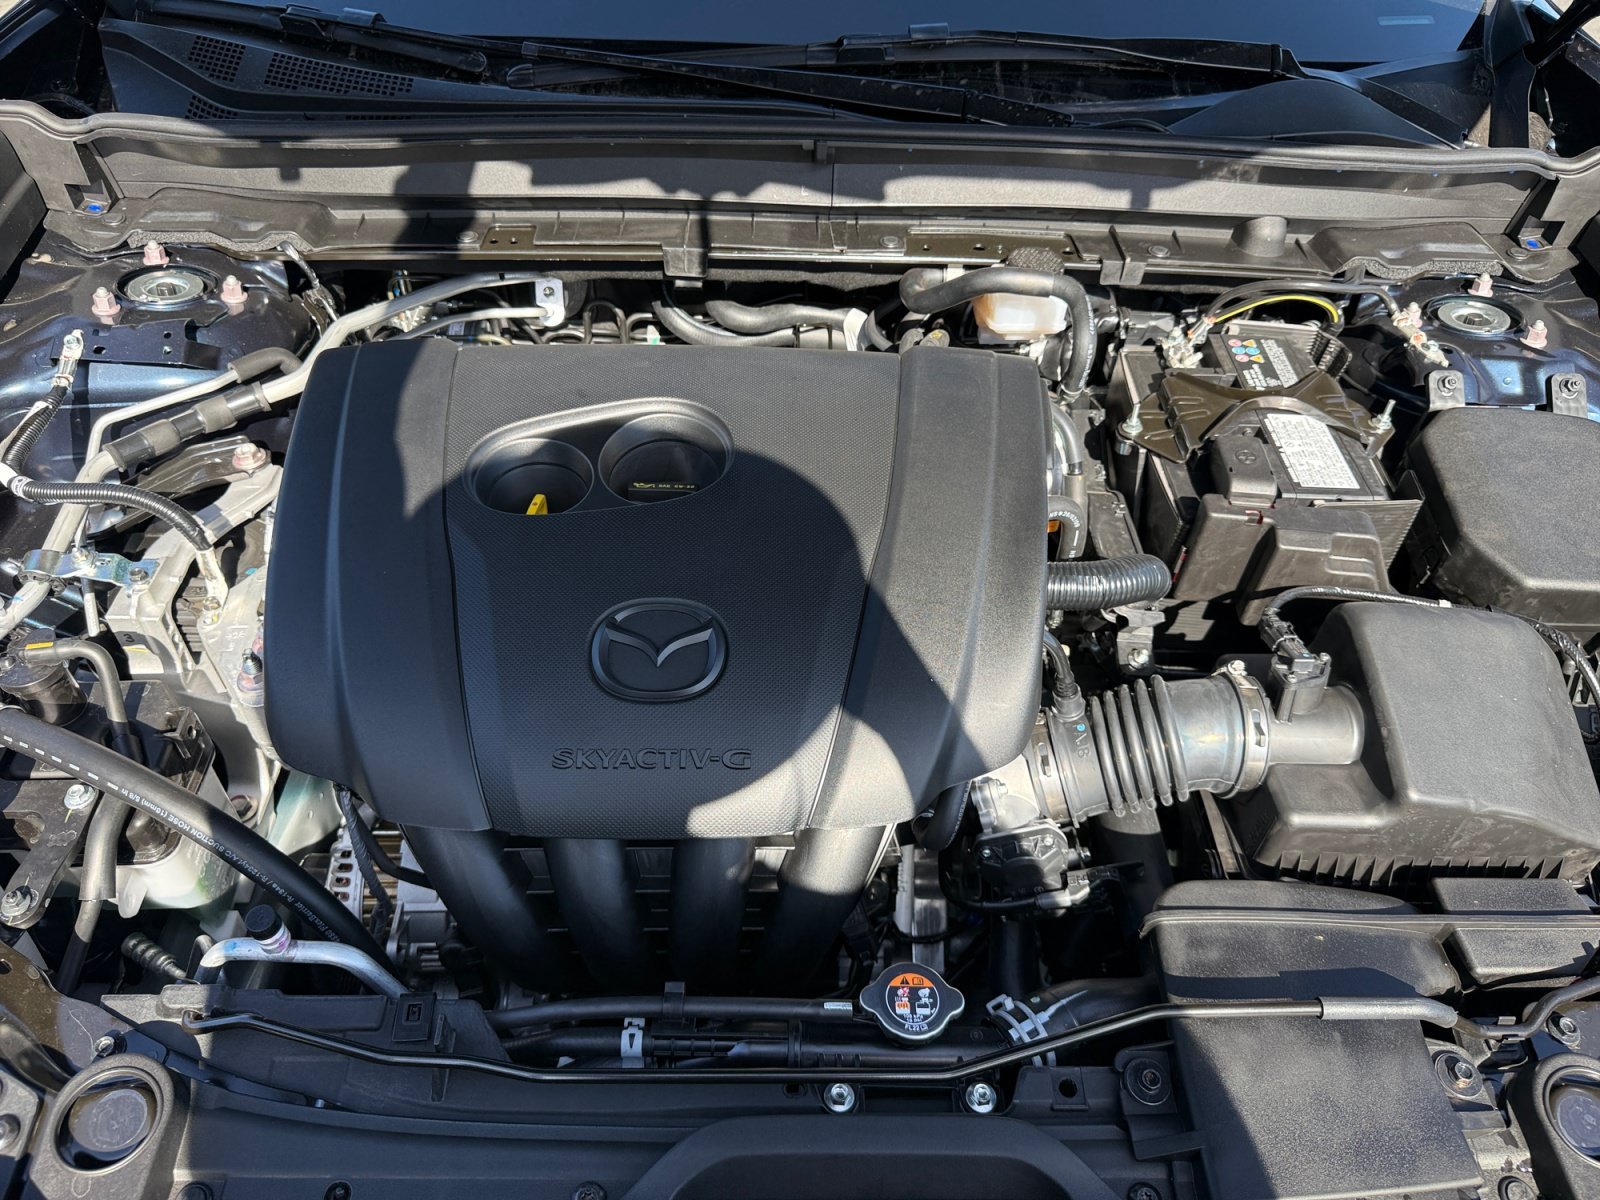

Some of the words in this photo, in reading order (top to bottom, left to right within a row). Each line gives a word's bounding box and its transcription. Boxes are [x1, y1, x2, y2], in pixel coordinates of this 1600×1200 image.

[551, 748, 752, 770] SKYACTIV-G
[139, 797, 169, 818] (16mm)
[166, 813, 191, 831] HOSE
[189, 827, 226, 852] SUCTION
